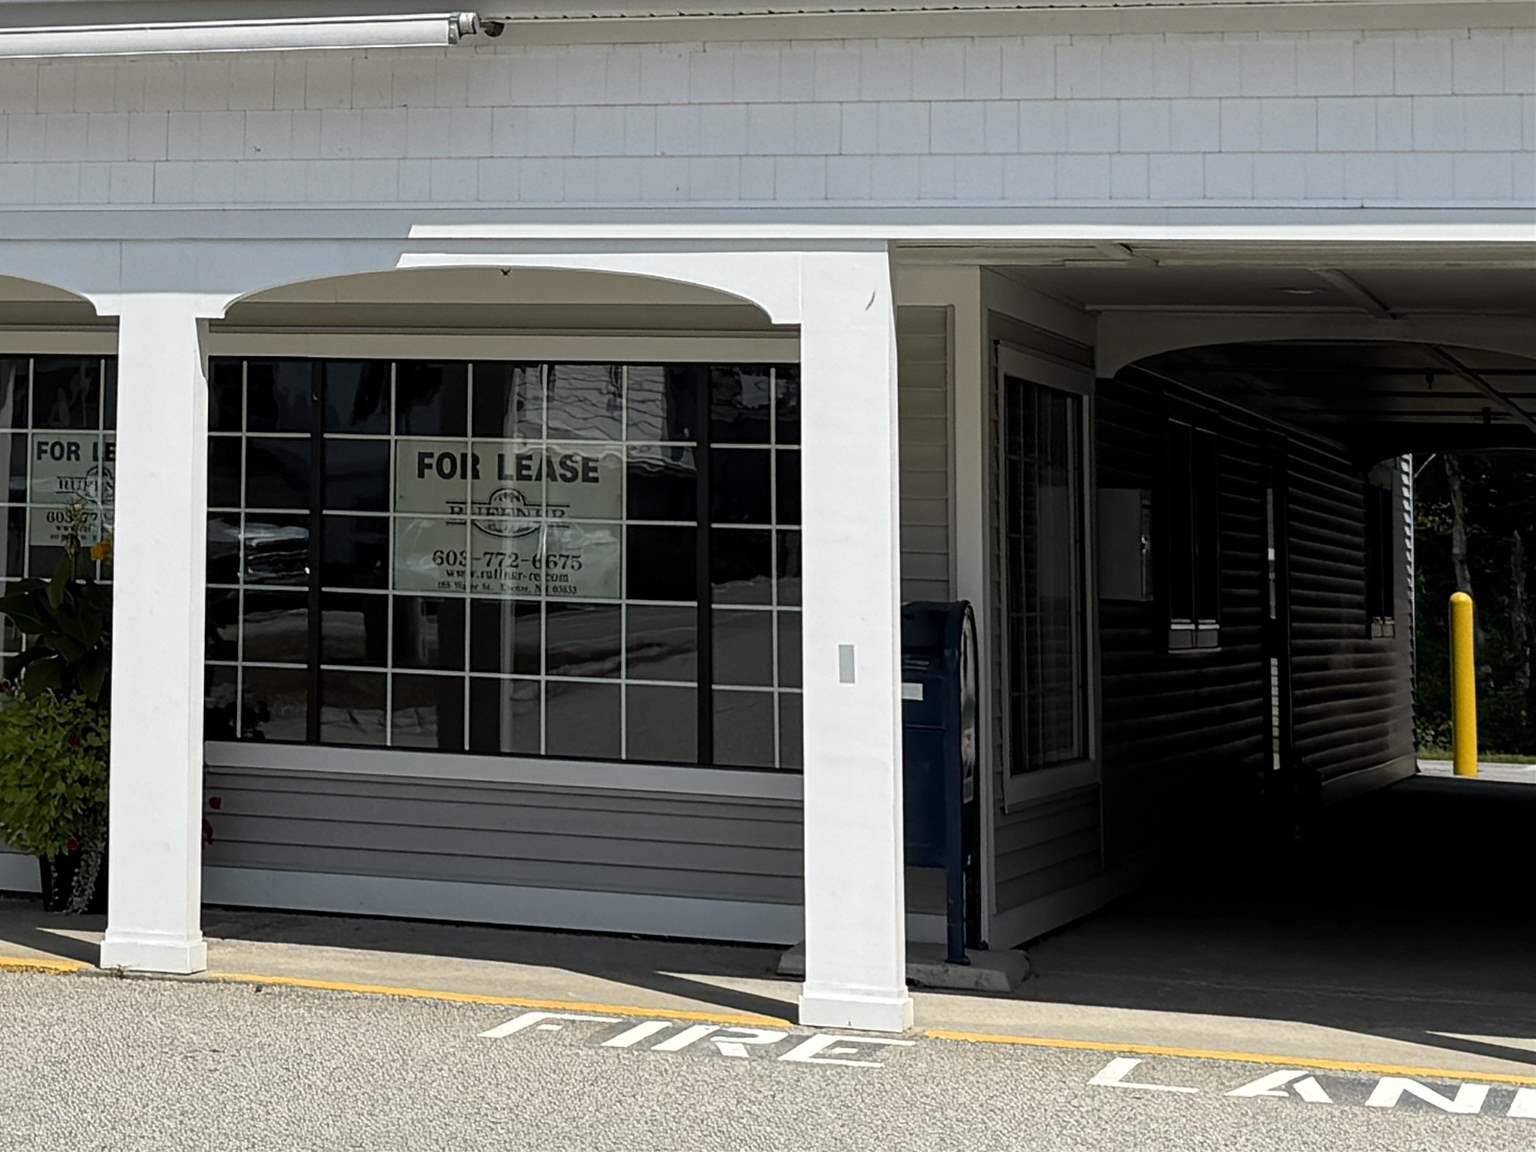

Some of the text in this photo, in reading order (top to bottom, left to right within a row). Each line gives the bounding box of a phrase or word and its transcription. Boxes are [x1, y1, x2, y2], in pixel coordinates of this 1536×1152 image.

[36, 441, 80, 461] FOR
[417, 451, 600, 483] FOR LEASE
[432, 549, 583, 572] 603-772-6675
[477, 1011, 916, 1068] FIRE
